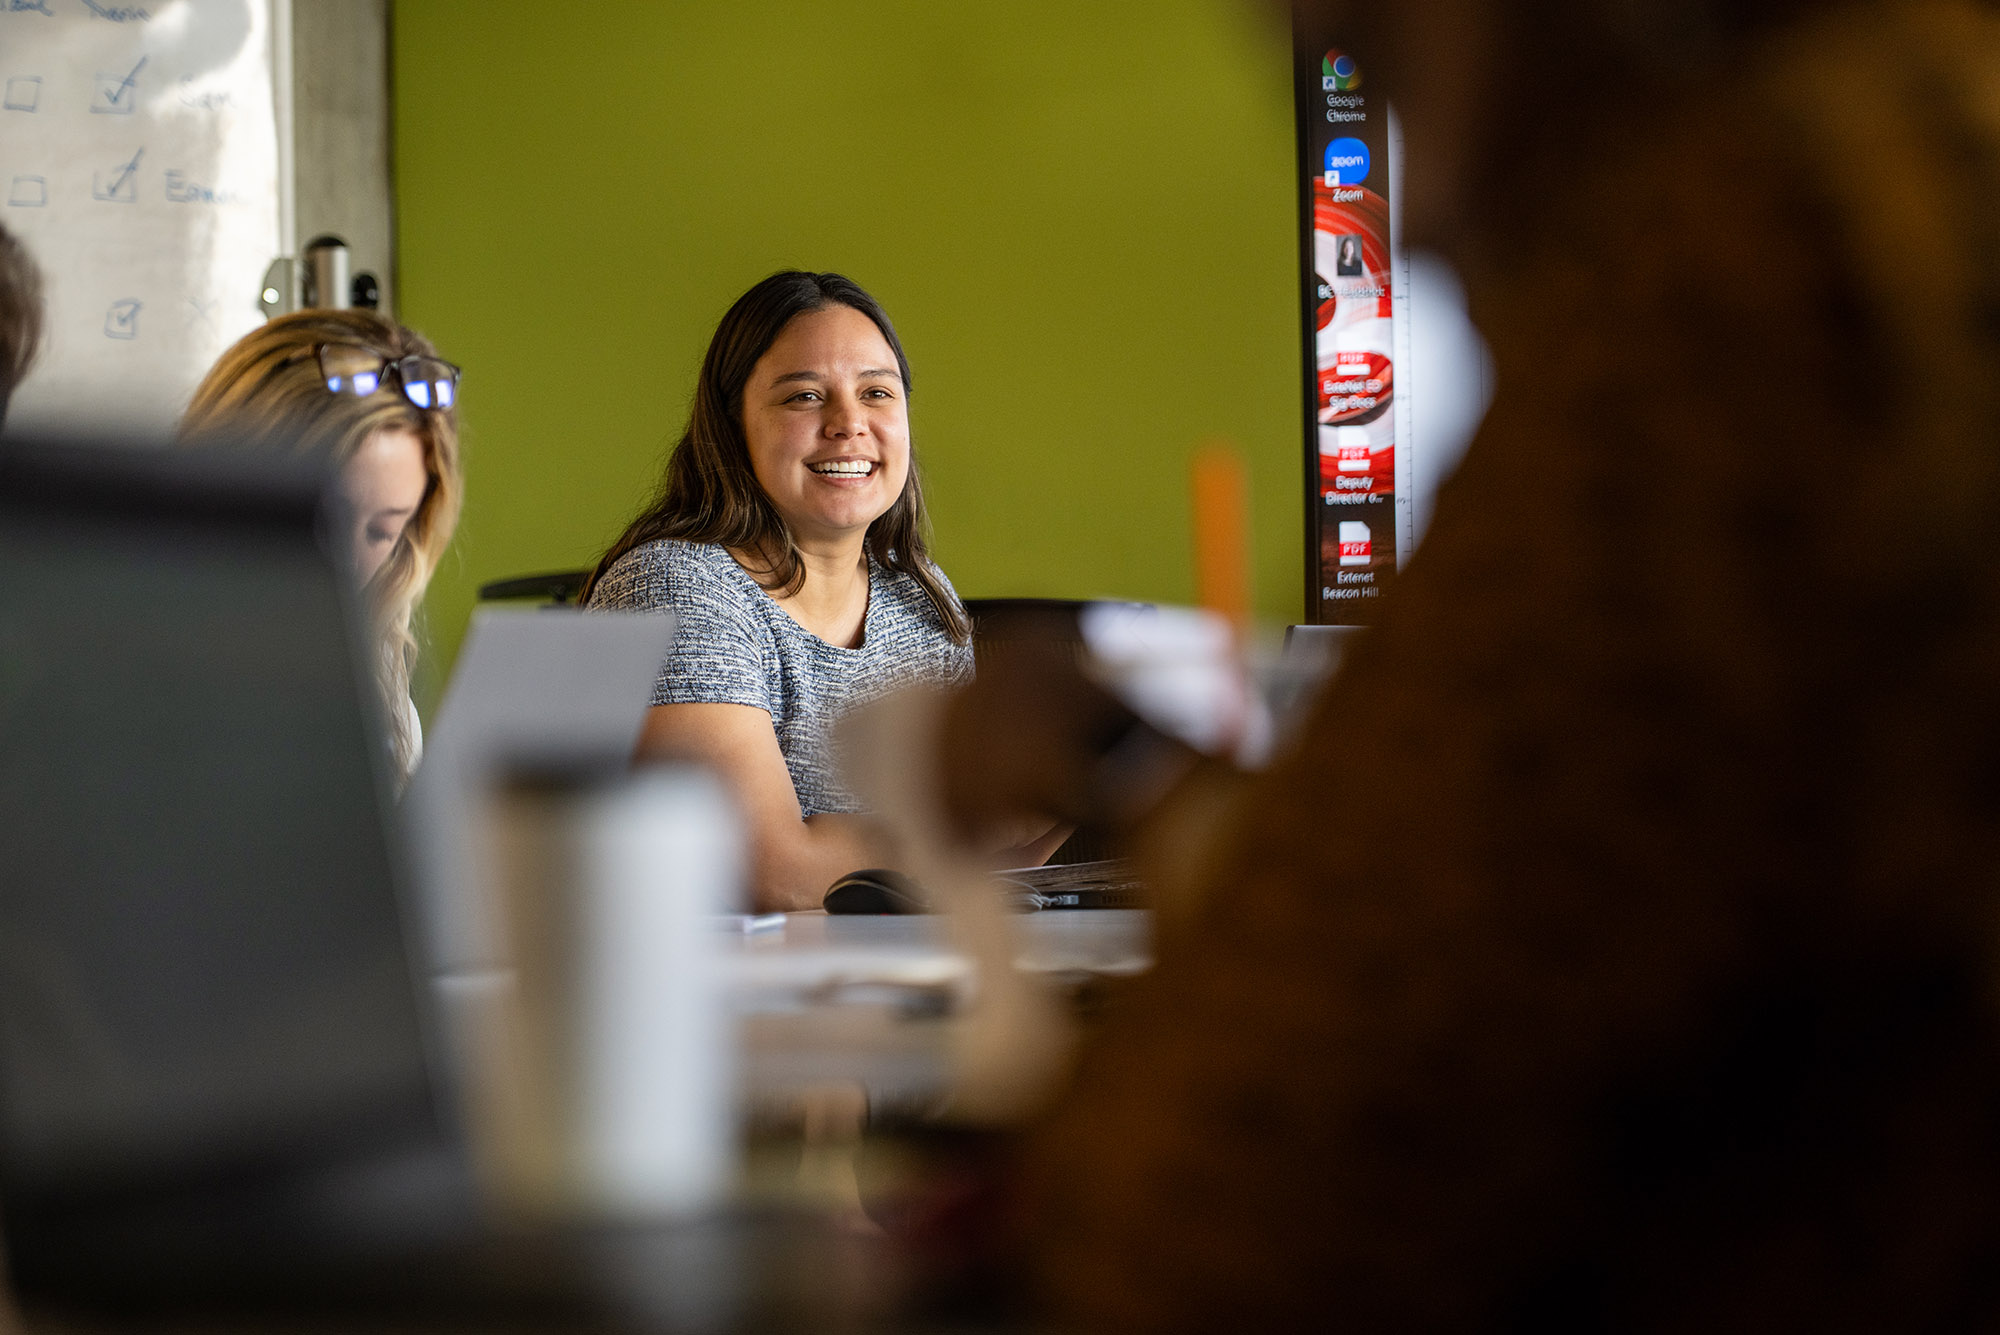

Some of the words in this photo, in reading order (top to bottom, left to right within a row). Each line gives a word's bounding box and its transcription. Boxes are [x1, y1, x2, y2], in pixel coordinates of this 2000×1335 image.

[1326, 93, 1364, 108] Google
[1326, 109, 1366, 122] Chrome
[1331, 155, 1364, 168] zoom
[1332, 188, 1363, 203] Zoom
[1341, 450, 1365, 460] PDF
[1336, 475, 1374, 491] Deputy
[1325, 491, 1367, 506] Director
[1343, 543, 1366, 556] PDF
[1337, 571, 1374, 585] Extenet
[1322, 587, 1360, 600] Beacon
